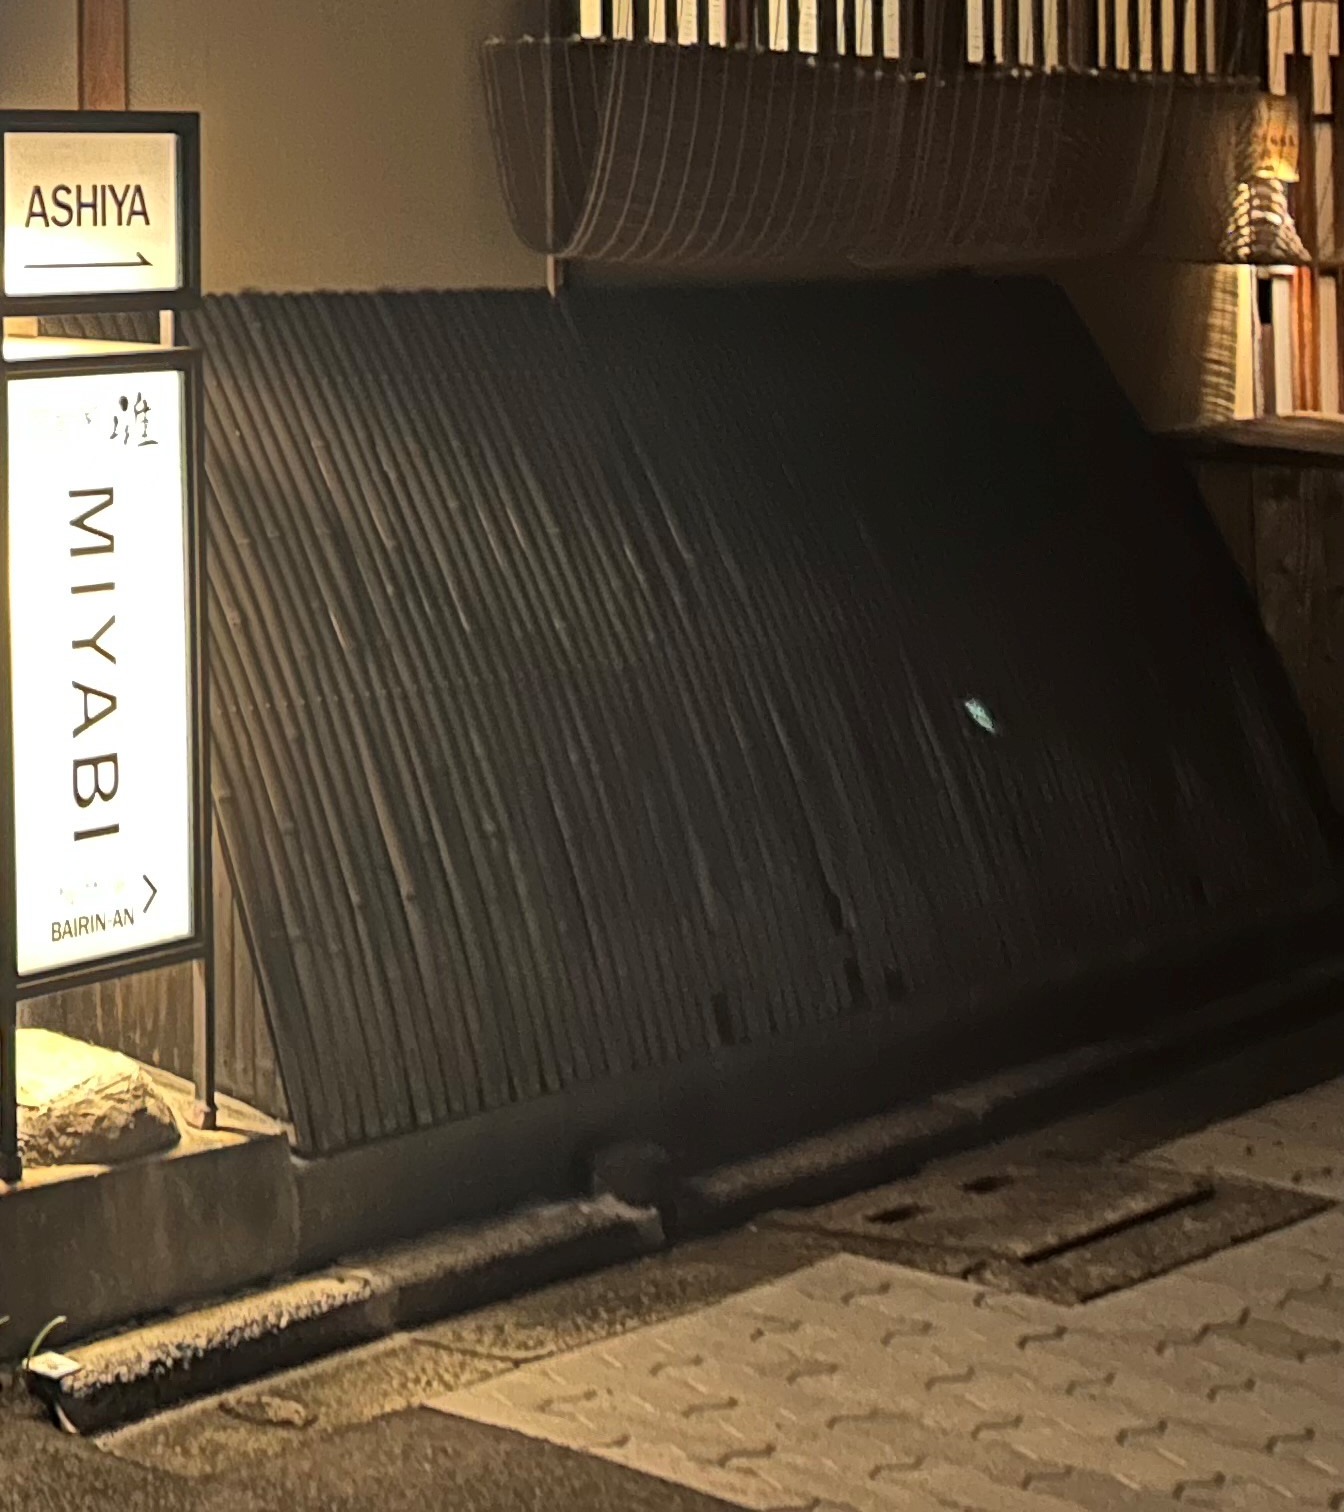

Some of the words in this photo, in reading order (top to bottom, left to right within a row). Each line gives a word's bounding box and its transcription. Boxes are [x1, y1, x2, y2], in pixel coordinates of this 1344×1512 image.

[25, 184, 151, 228] ASHIYA
[68, 486, 120, 842] MIYABI
[51, 907, 136, 943] BAIRIN-AN
